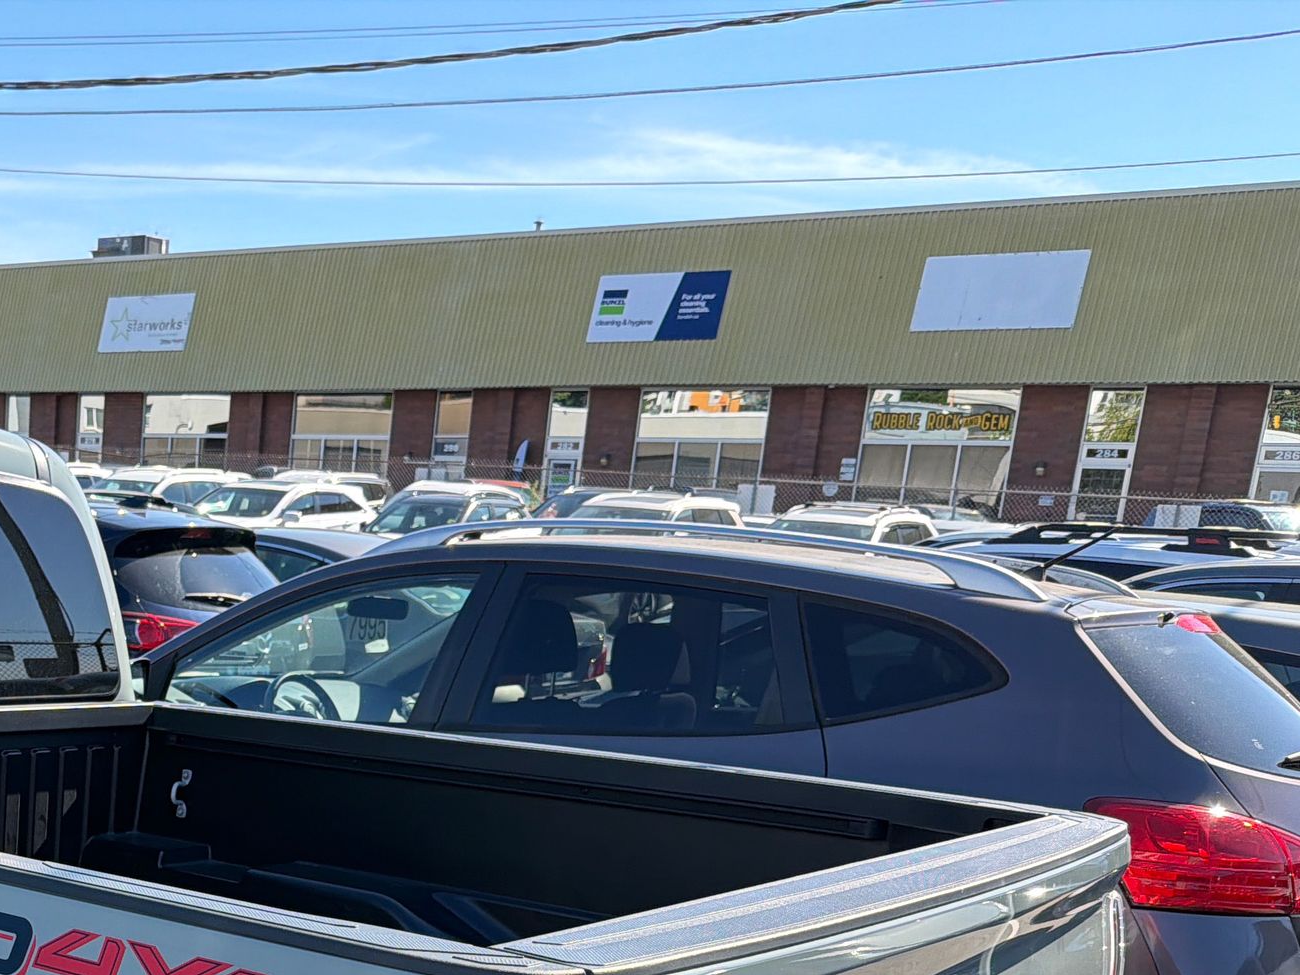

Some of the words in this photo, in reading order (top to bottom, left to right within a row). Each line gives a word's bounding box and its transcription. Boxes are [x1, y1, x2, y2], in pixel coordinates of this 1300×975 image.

[126, 318, 183, 332] starworks
[628, 319, 654, 327] hygiene
[872, 411, 921, 430] RUBBLE
[925, 411, 961, 430] ROCK
[981, 412, 1010, 430] GEM
[1094, 449, 1118, 458] 284
[1275, 451, 1300, 460] 286
